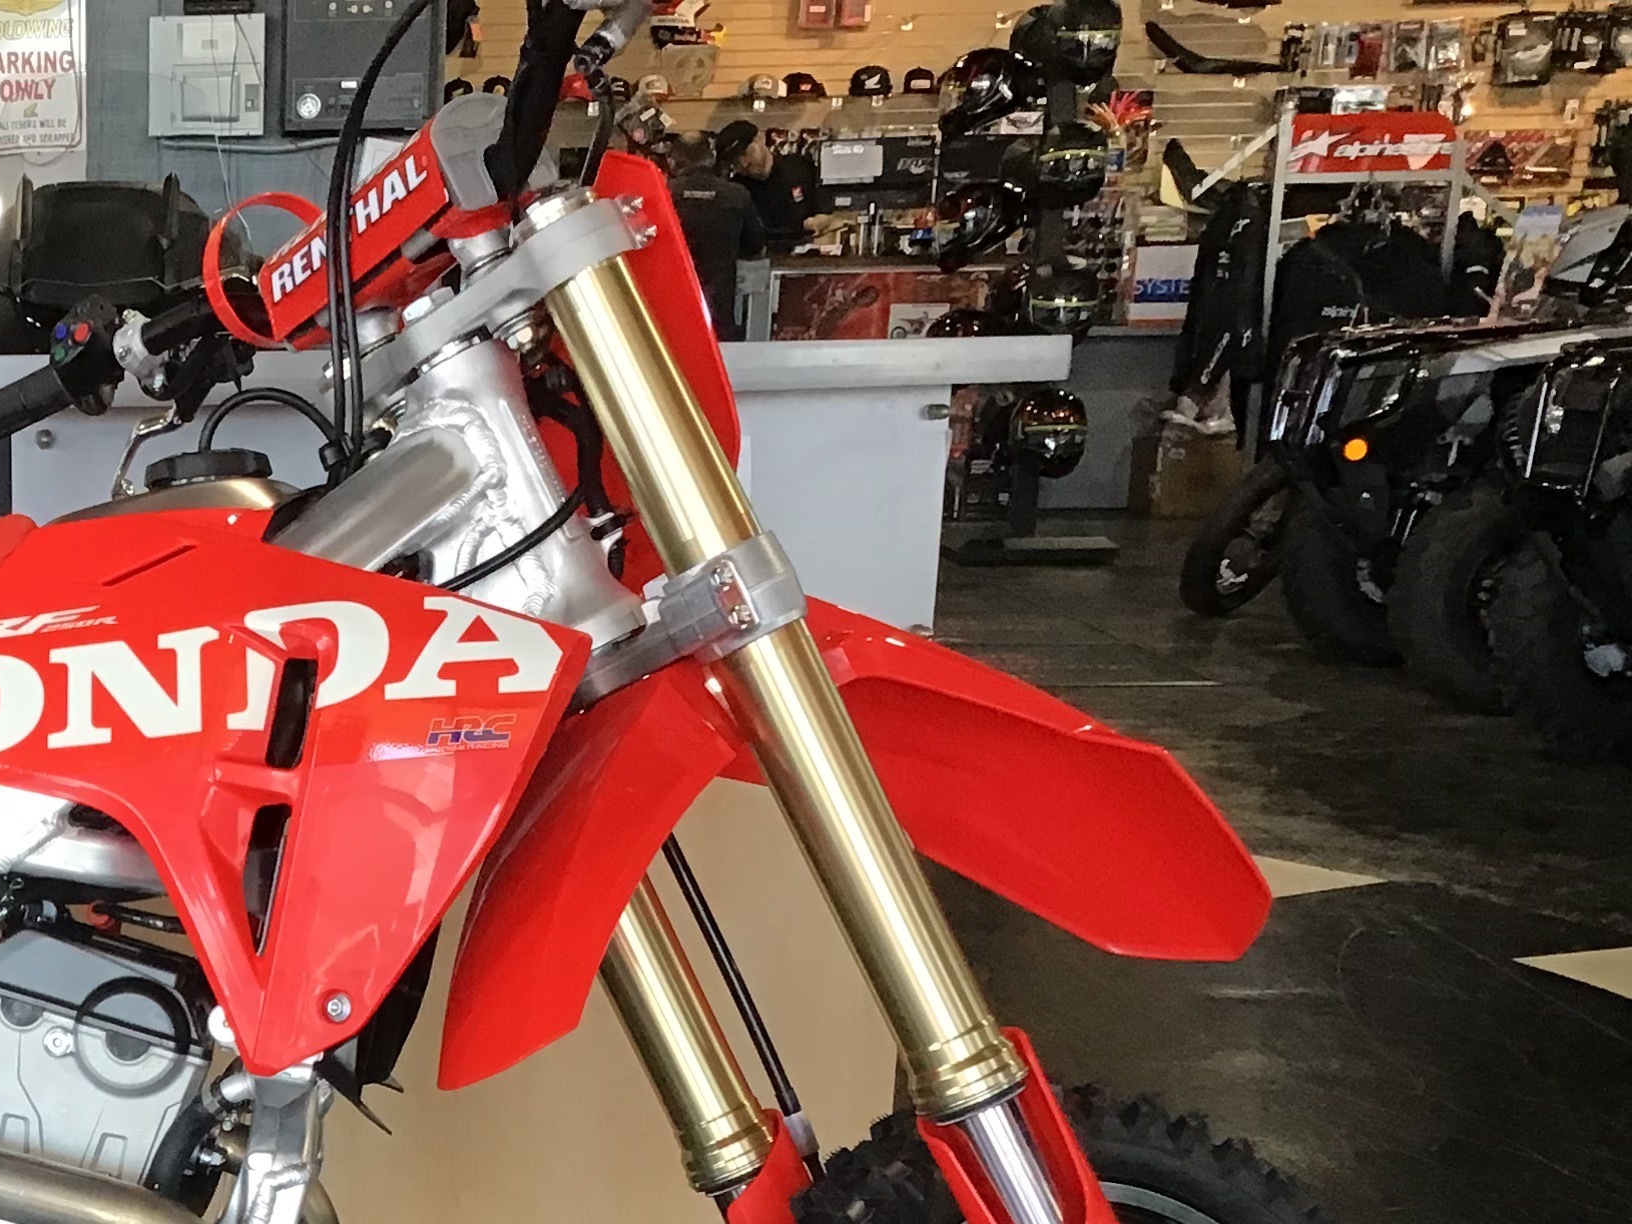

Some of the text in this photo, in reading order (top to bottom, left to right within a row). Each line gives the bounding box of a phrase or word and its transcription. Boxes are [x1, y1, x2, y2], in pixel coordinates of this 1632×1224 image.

[0, 78, 57, 102] ONLY
[271, 154, 428, 303] RENHAL
[426, 713, 517, 746] HRC
